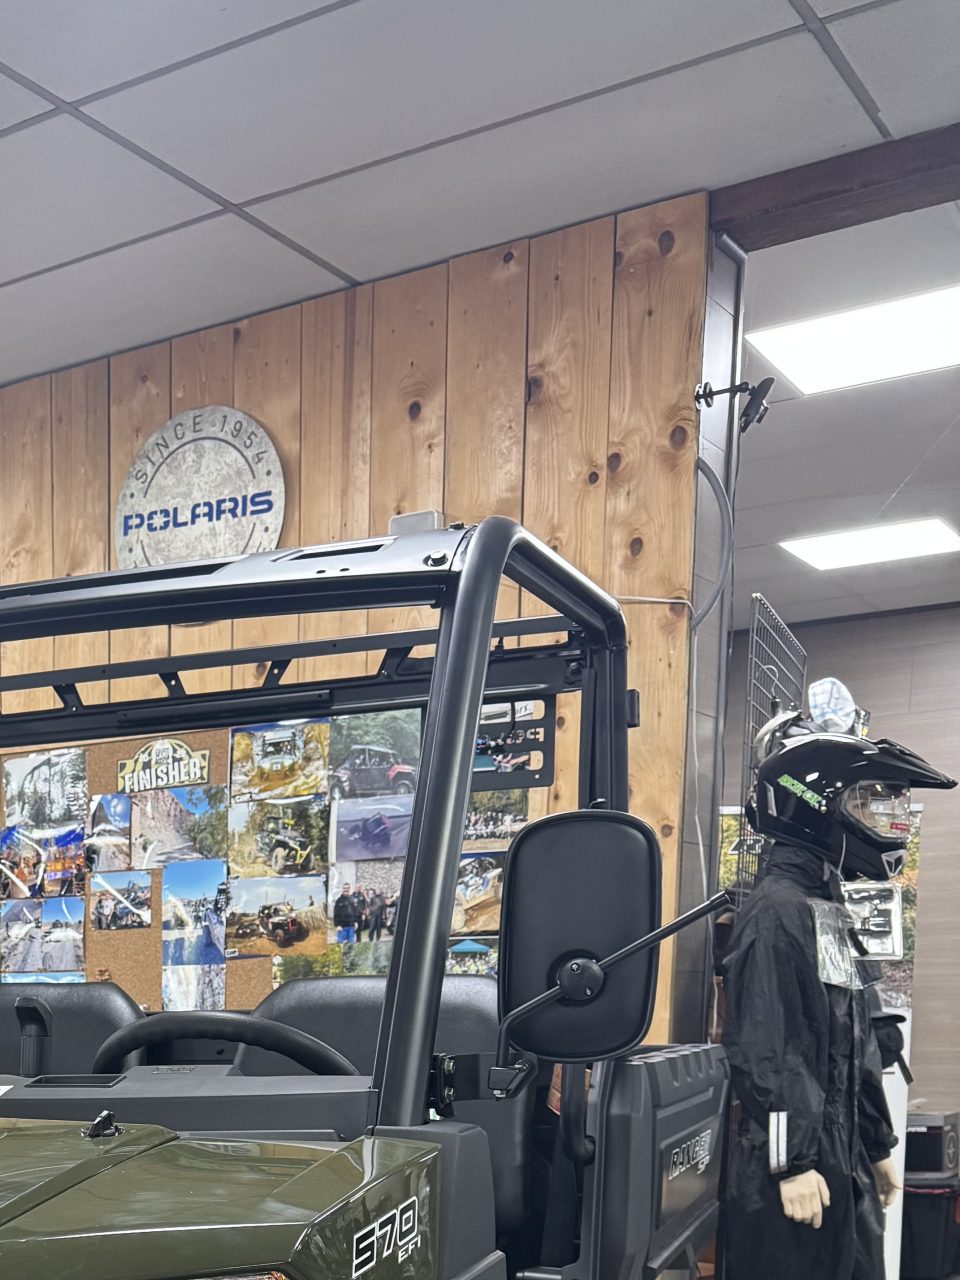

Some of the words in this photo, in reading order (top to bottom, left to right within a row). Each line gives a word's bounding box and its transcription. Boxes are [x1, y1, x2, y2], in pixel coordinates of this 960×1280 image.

[135, 414, 203, 484] SINCE
[220, 414, 268, 465] 1954
[122, 490, 274, 537] POLARIS
[124, 758, 201, 793] FINISHER
[351, 1195, 418, 1279] 570
[398, 1234, 421, 1264] EFI
